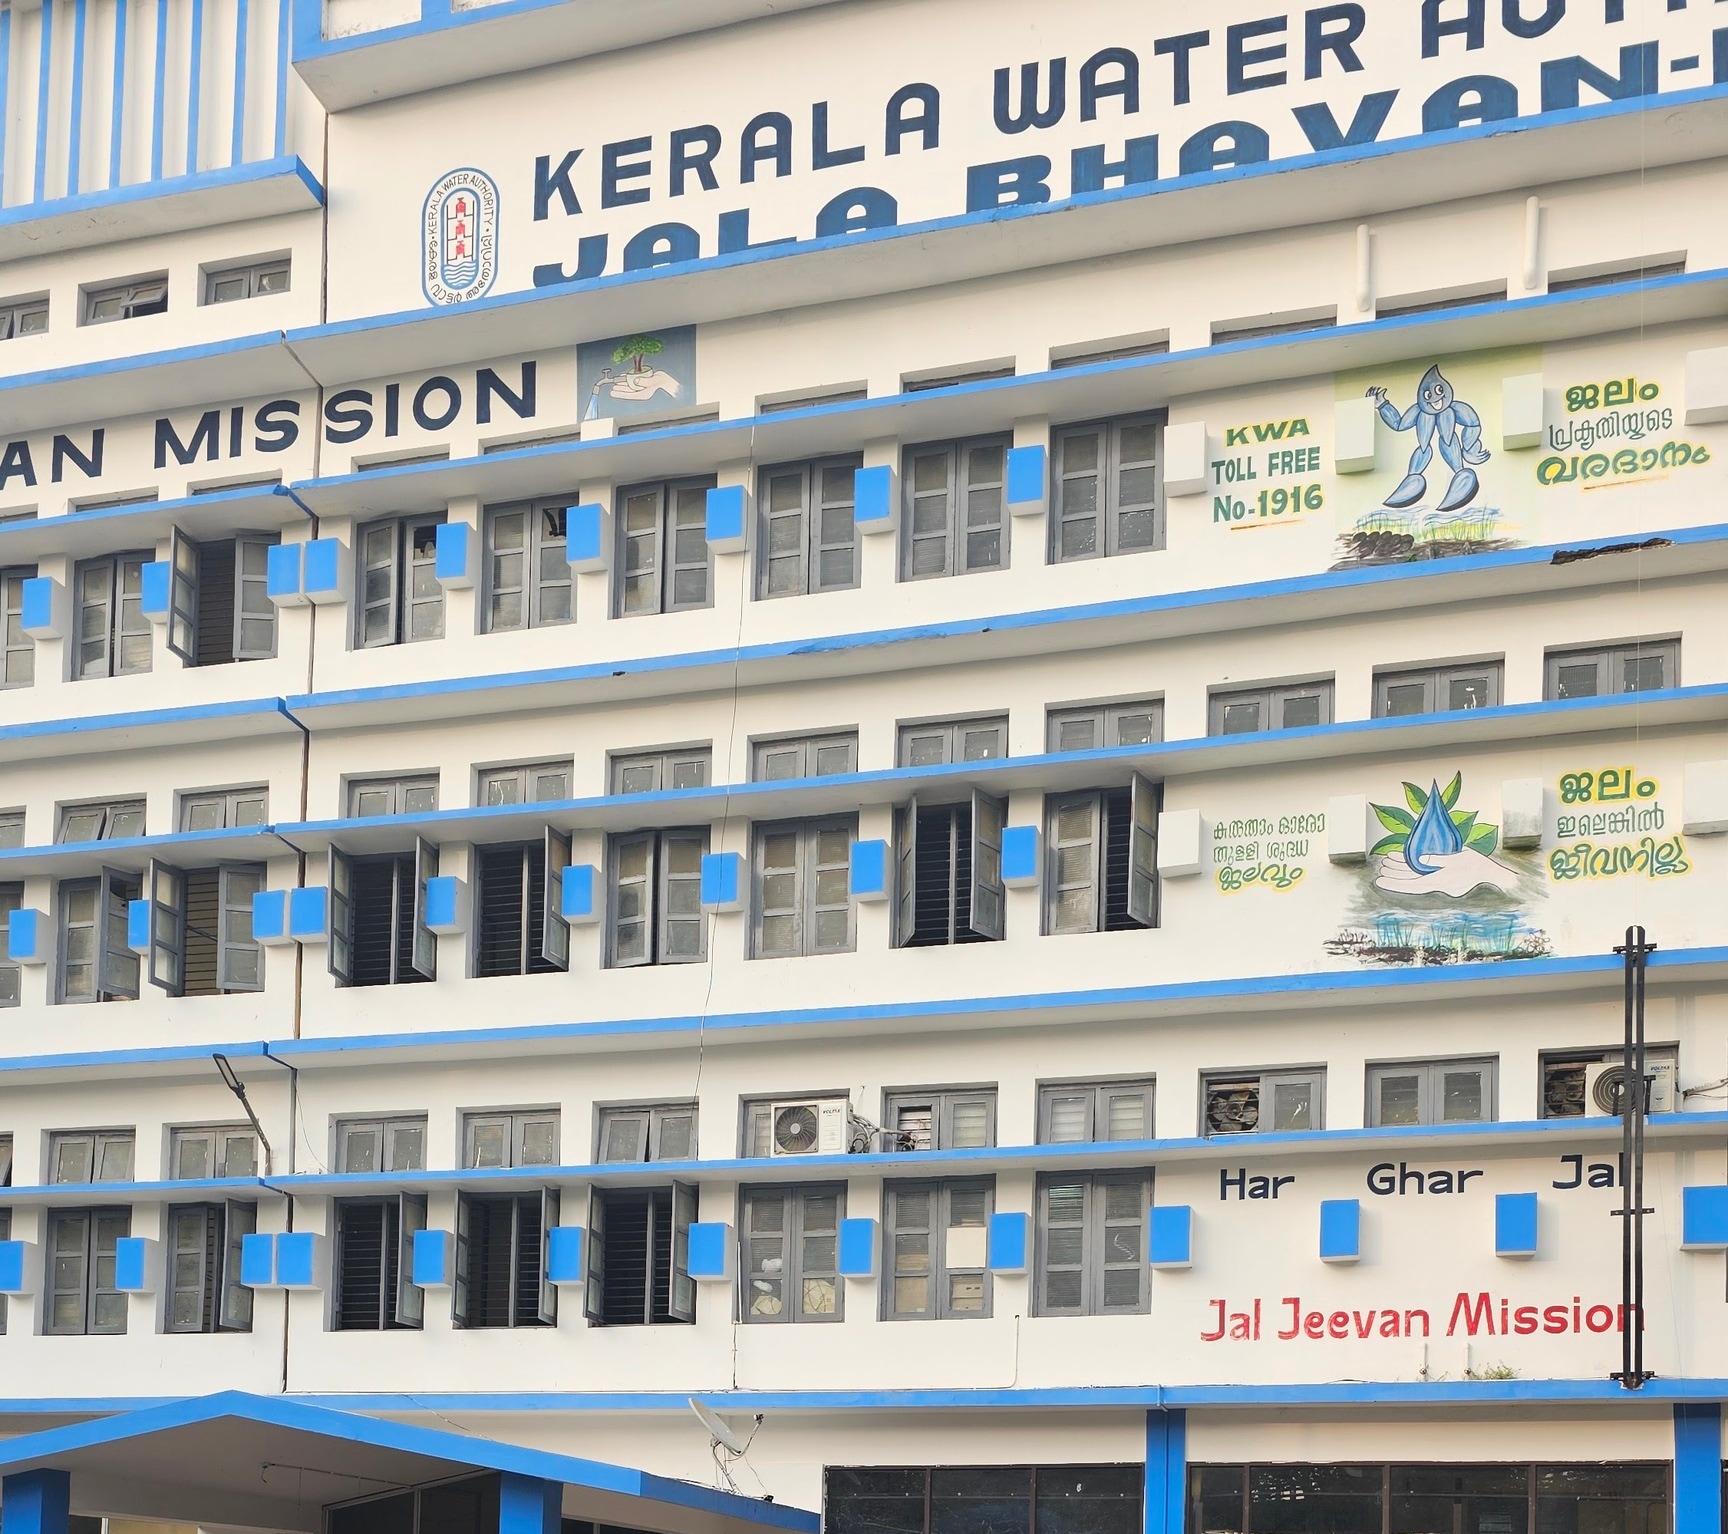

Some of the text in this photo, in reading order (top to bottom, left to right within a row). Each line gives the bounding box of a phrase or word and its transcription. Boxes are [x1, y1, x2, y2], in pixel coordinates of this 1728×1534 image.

[533, 82, 940, 222] KERALA
[994, 2, 1366, 135] WATER
[428, 174, 495, 235] KERALA WATER AUTHORITY
[533, 186, 898, 288] JALA
[1566, 378, 1659, 412] ജലം
[0, 360, 537, 491] AN MISSION
[1226, 419, 1310, 447] KWA
[1211, 446, 1320, 485] TOLL FREE
[1536, 441, 1711, 486] വരദാനം
[1560, 769, 1656, 804] ജലം
[1219, 862, 1304, 891] ജലവും
[1549, 836, 1689, 881] ജീവനില്ല
[1220, 1152, 1625, 1201] Har Ghar Jal
[1200, 1298, 1261, 1342] Jal
[1277, 1297, 1430, 1339] Jeevan
